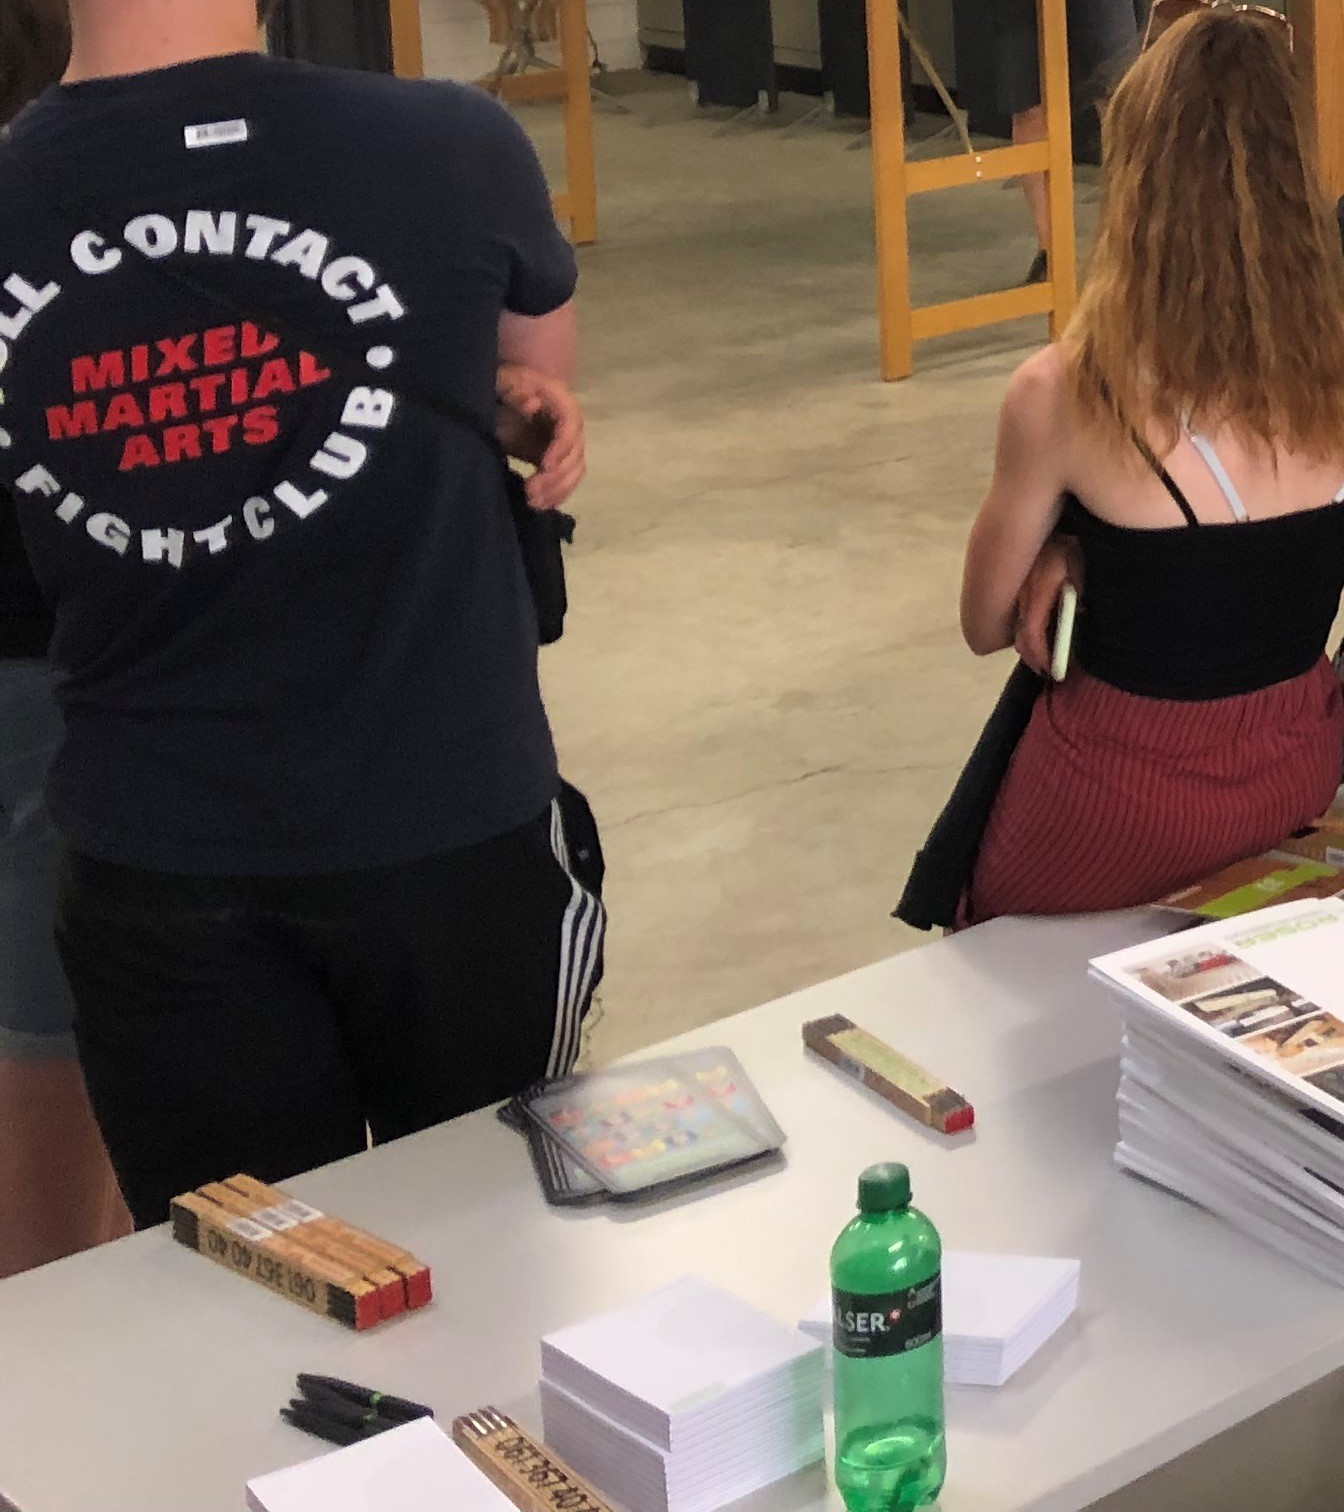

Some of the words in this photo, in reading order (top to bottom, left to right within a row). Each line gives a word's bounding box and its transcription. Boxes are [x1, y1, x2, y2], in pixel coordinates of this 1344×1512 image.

[70, 210, 405, 325] CONTACT
[46, 351, 331, 441] MARTIAL
[118, 405, 279, 471] ARTS
